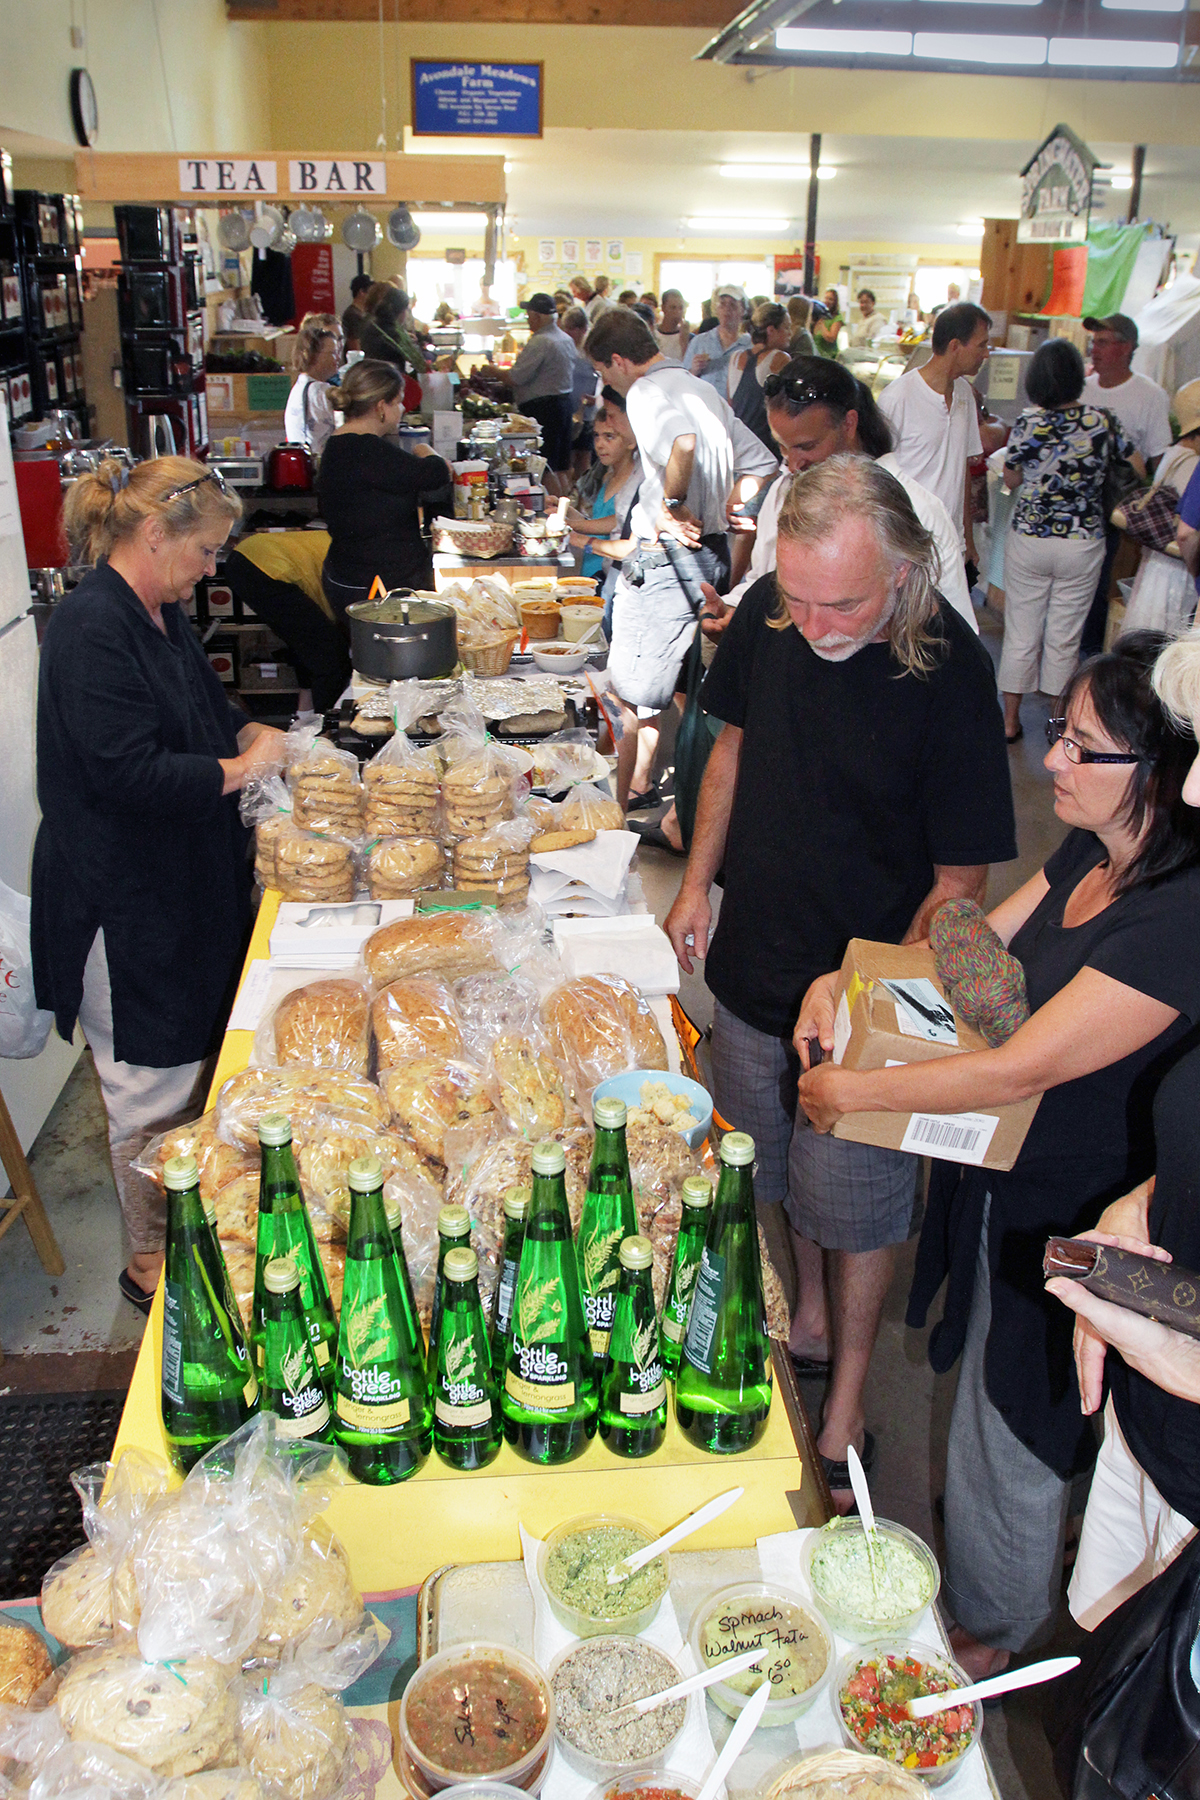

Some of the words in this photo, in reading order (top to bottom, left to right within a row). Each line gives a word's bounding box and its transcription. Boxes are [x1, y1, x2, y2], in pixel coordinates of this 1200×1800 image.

[420, 65, 476, 86] Avondale
[480, 65, 536, 87] Meadows
[461, 76, 494, 88] Farm
[187, 161, 267, 190] TEA
[298, 161, 375, 191] BAR
[513, 1332, 558, 1364] bottle
[343, 1356, 391, 1384] bottle
[519, 1357, 568, 1377] green
[529, 1373, 568, 1382] SPARKLING
[351, 1378, 401, 1400] green
[442, 1375, 477, 1393] bottle
[282, 1387, 318, 1407] bottle
[292, 1392, 323, 1417] green
[362, 1391, 402, 1402] SPARKLING
[449, 1389, 484, 1405] green
[705, 1632, 766, 1658] Walnut
[766, 1628, 809, 1649] Feta
